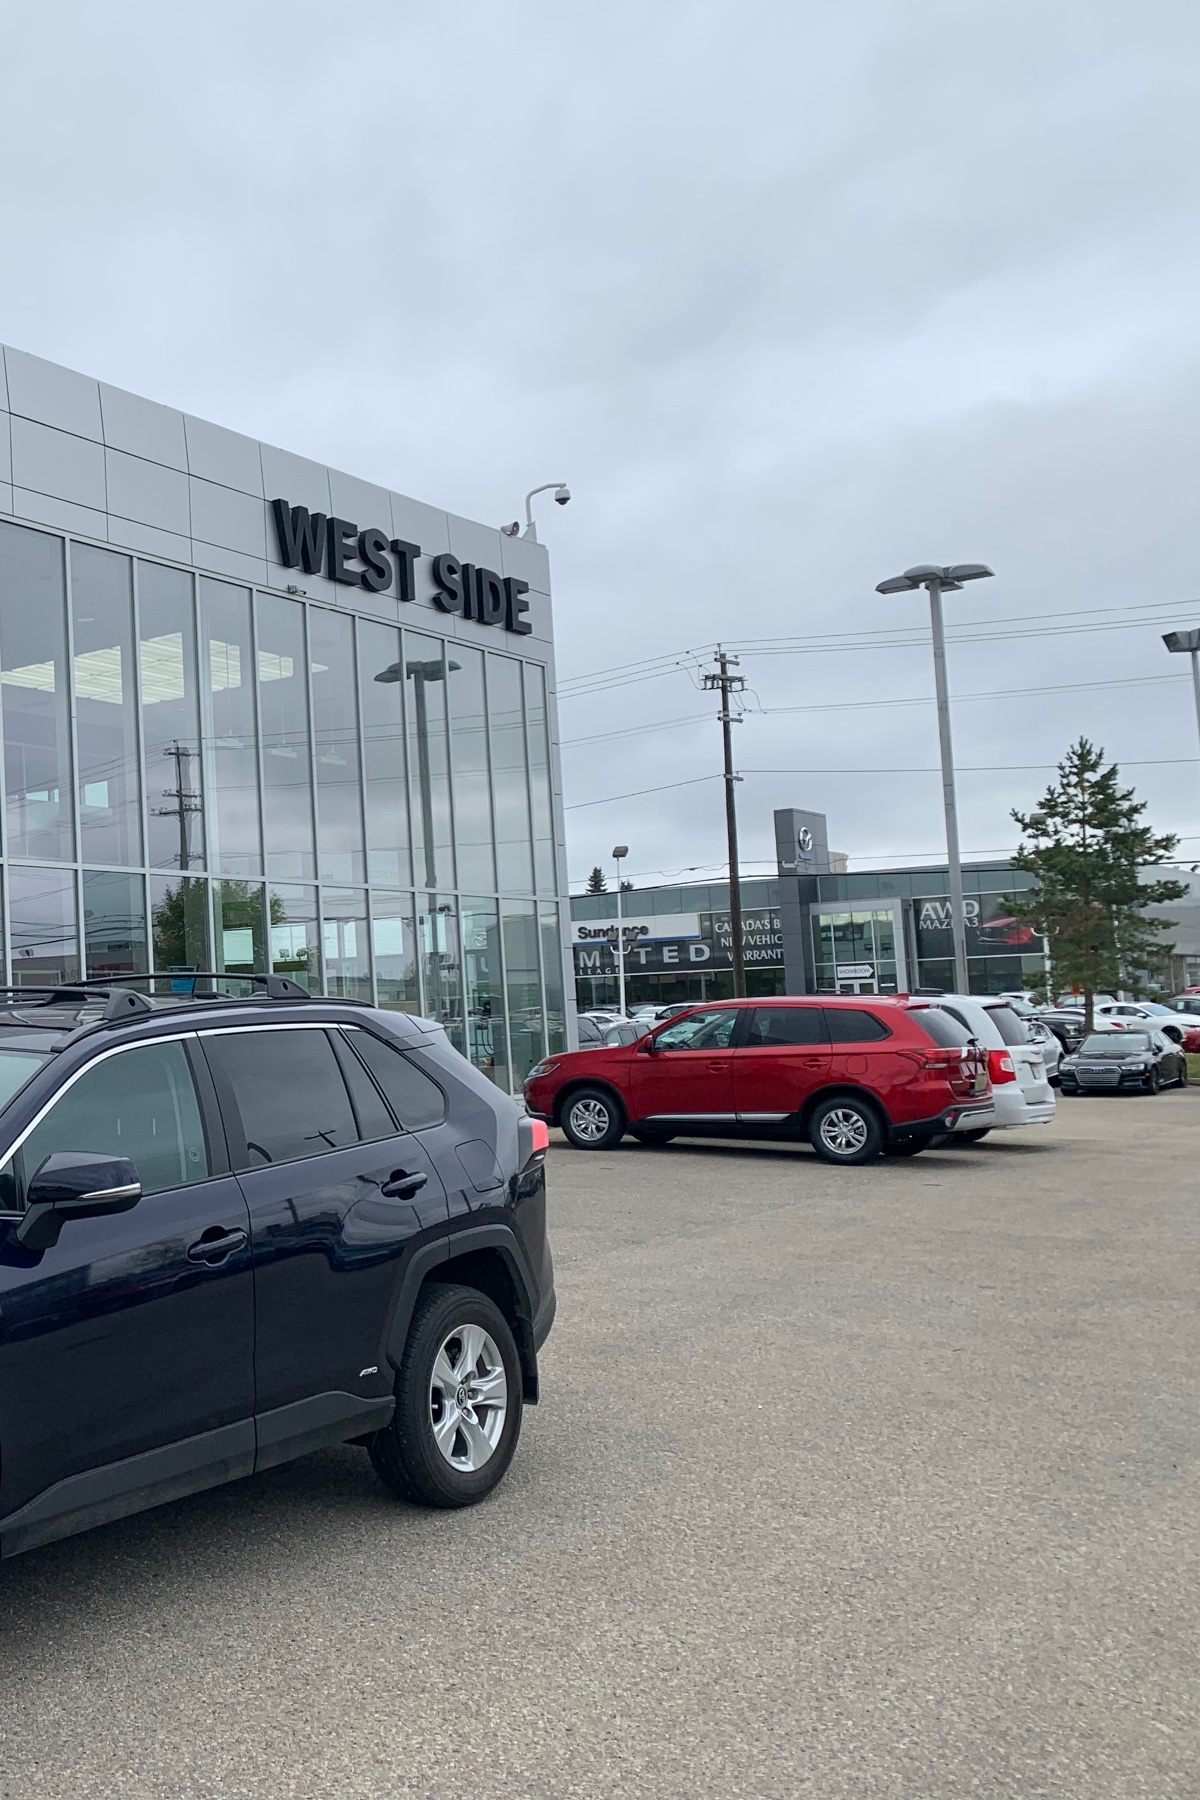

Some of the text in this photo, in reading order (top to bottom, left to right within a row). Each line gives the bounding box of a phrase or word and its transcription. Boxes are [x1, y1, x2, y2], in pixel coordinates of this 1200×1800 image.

[272, 498, 532, 635] WEST SIDE
[920, 900, 980, 920] AWD
[715, 919, 771, 933] CAADA'S
[919, 917, 979, 930] MAZA3
[839, 967, 871, 975] SHOWROOM
[359, 1366, 379, 1378] AWD
